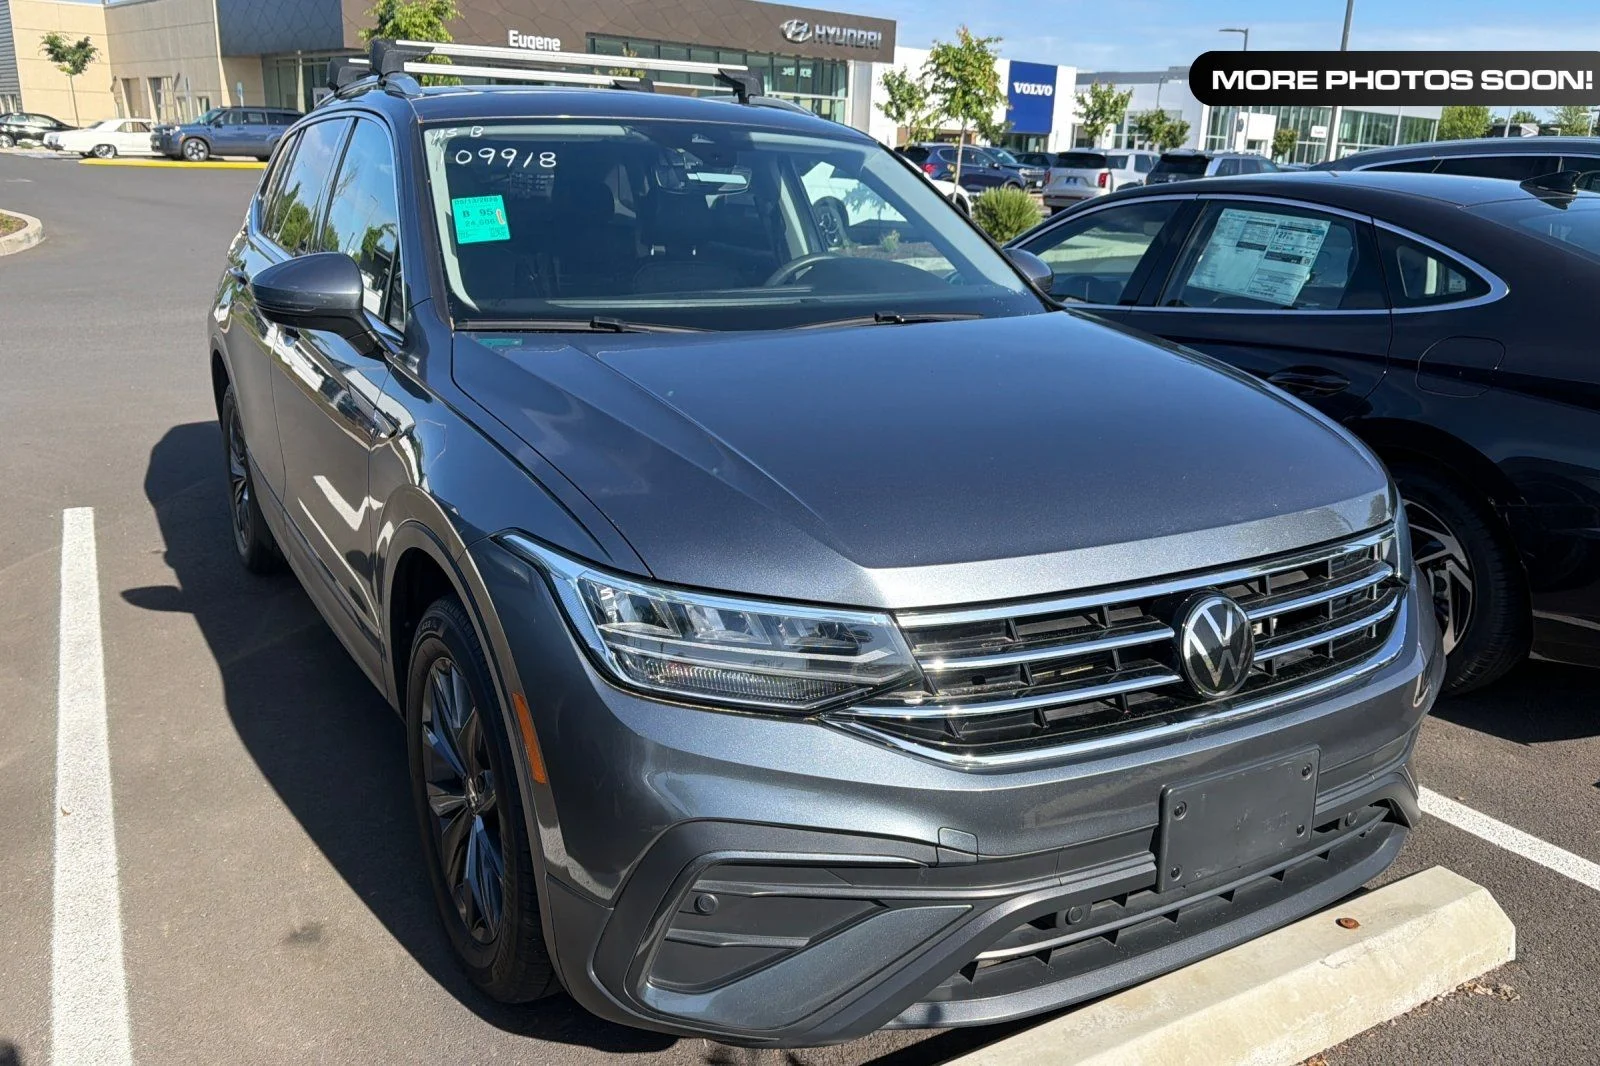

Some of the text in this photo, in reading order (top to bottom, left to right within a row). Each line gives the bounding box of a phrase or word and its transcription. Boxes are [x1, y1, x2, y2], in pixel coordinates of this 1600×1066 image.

[508, 29, 561, 51] Eugene
[815, 24, 882, 49] HYUNDAI
[1013, 81, 1053, 97] VOLVO
